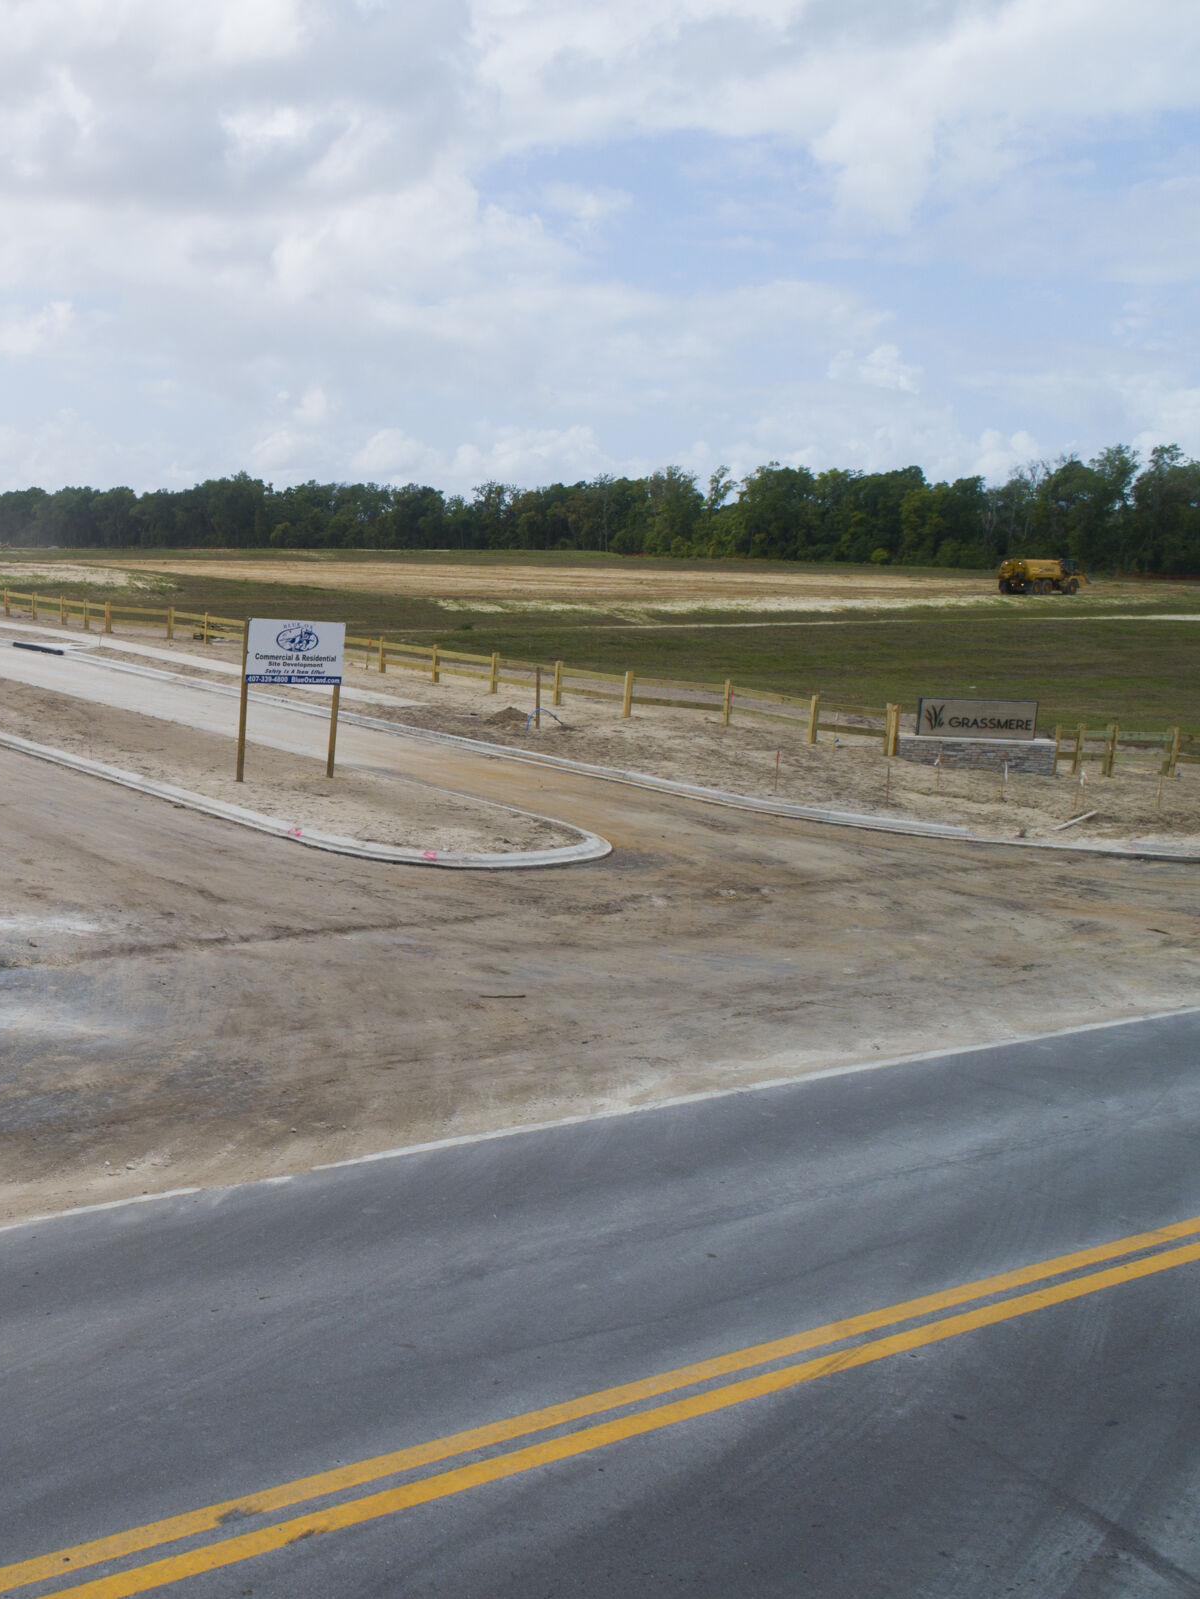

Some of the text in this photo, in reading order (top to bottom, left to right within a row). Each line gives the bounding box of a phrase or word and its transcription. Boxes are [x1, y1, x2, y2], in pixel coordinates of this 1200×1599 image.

[255, 653, 293, 661] Commercial
[291, 676, 340, 684] BlueOxLand.com
[948, 716, 1033, 731] GRASSMERE
